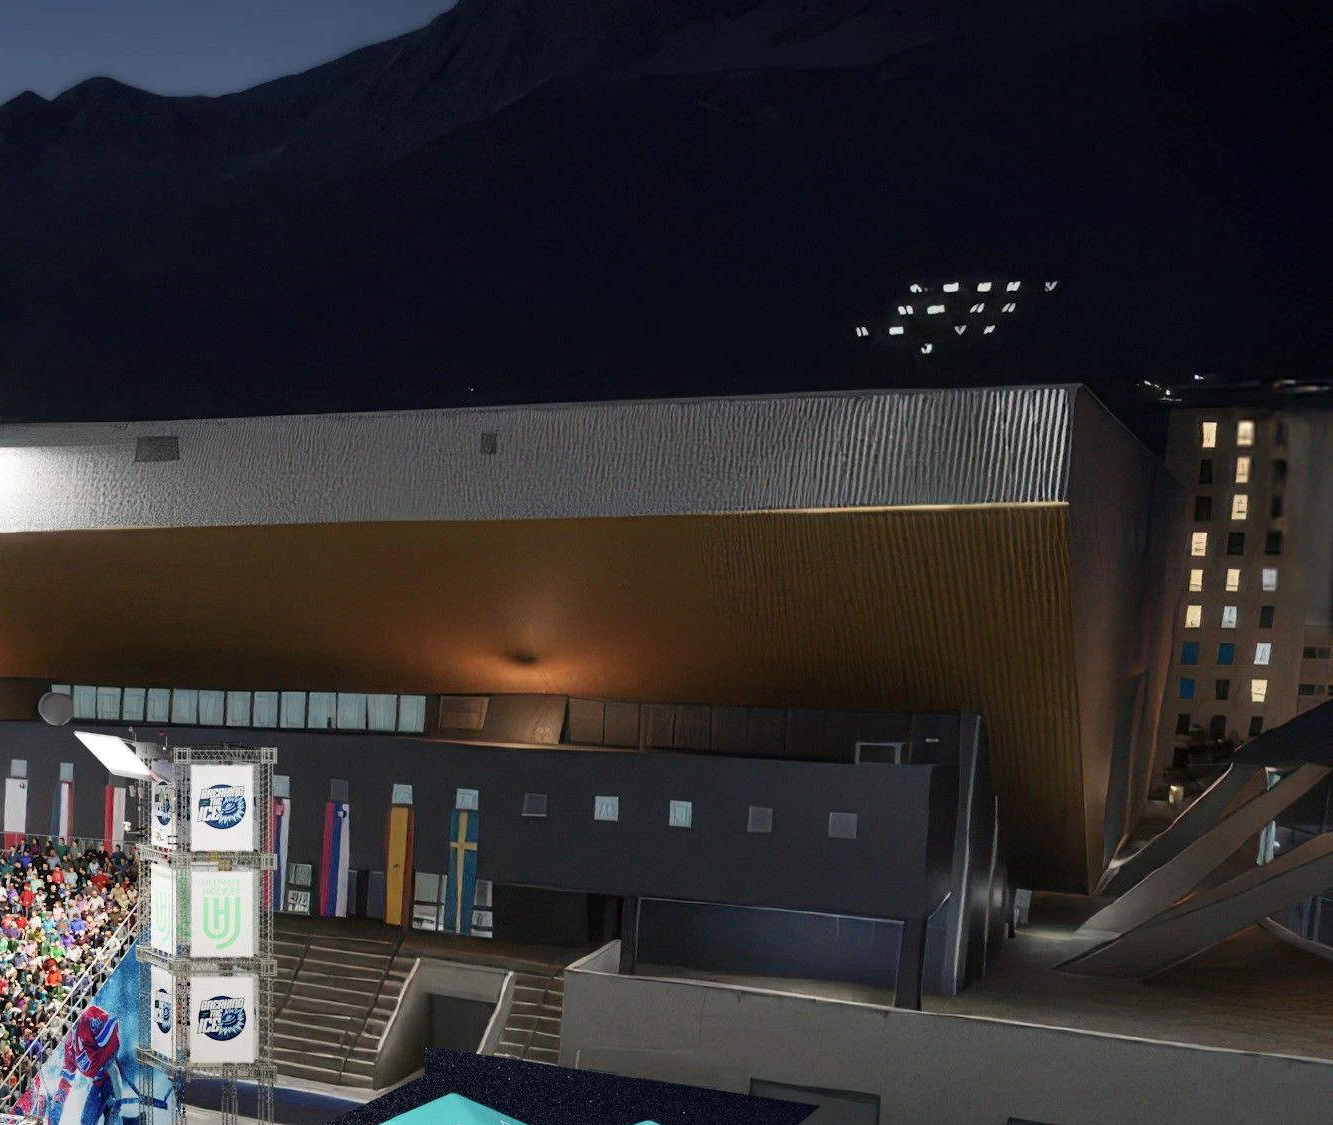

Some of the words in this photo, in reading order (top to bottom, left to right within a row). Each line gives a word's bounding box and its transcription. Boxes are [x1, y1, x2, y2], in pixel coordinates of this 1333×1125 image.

[200, 786, 244, 798] BREAKING
[197, 805, 222, 822] ICE
[200, 998, 244, 1010] BREAKING
[197, 1017, 222, 1034] ICE
